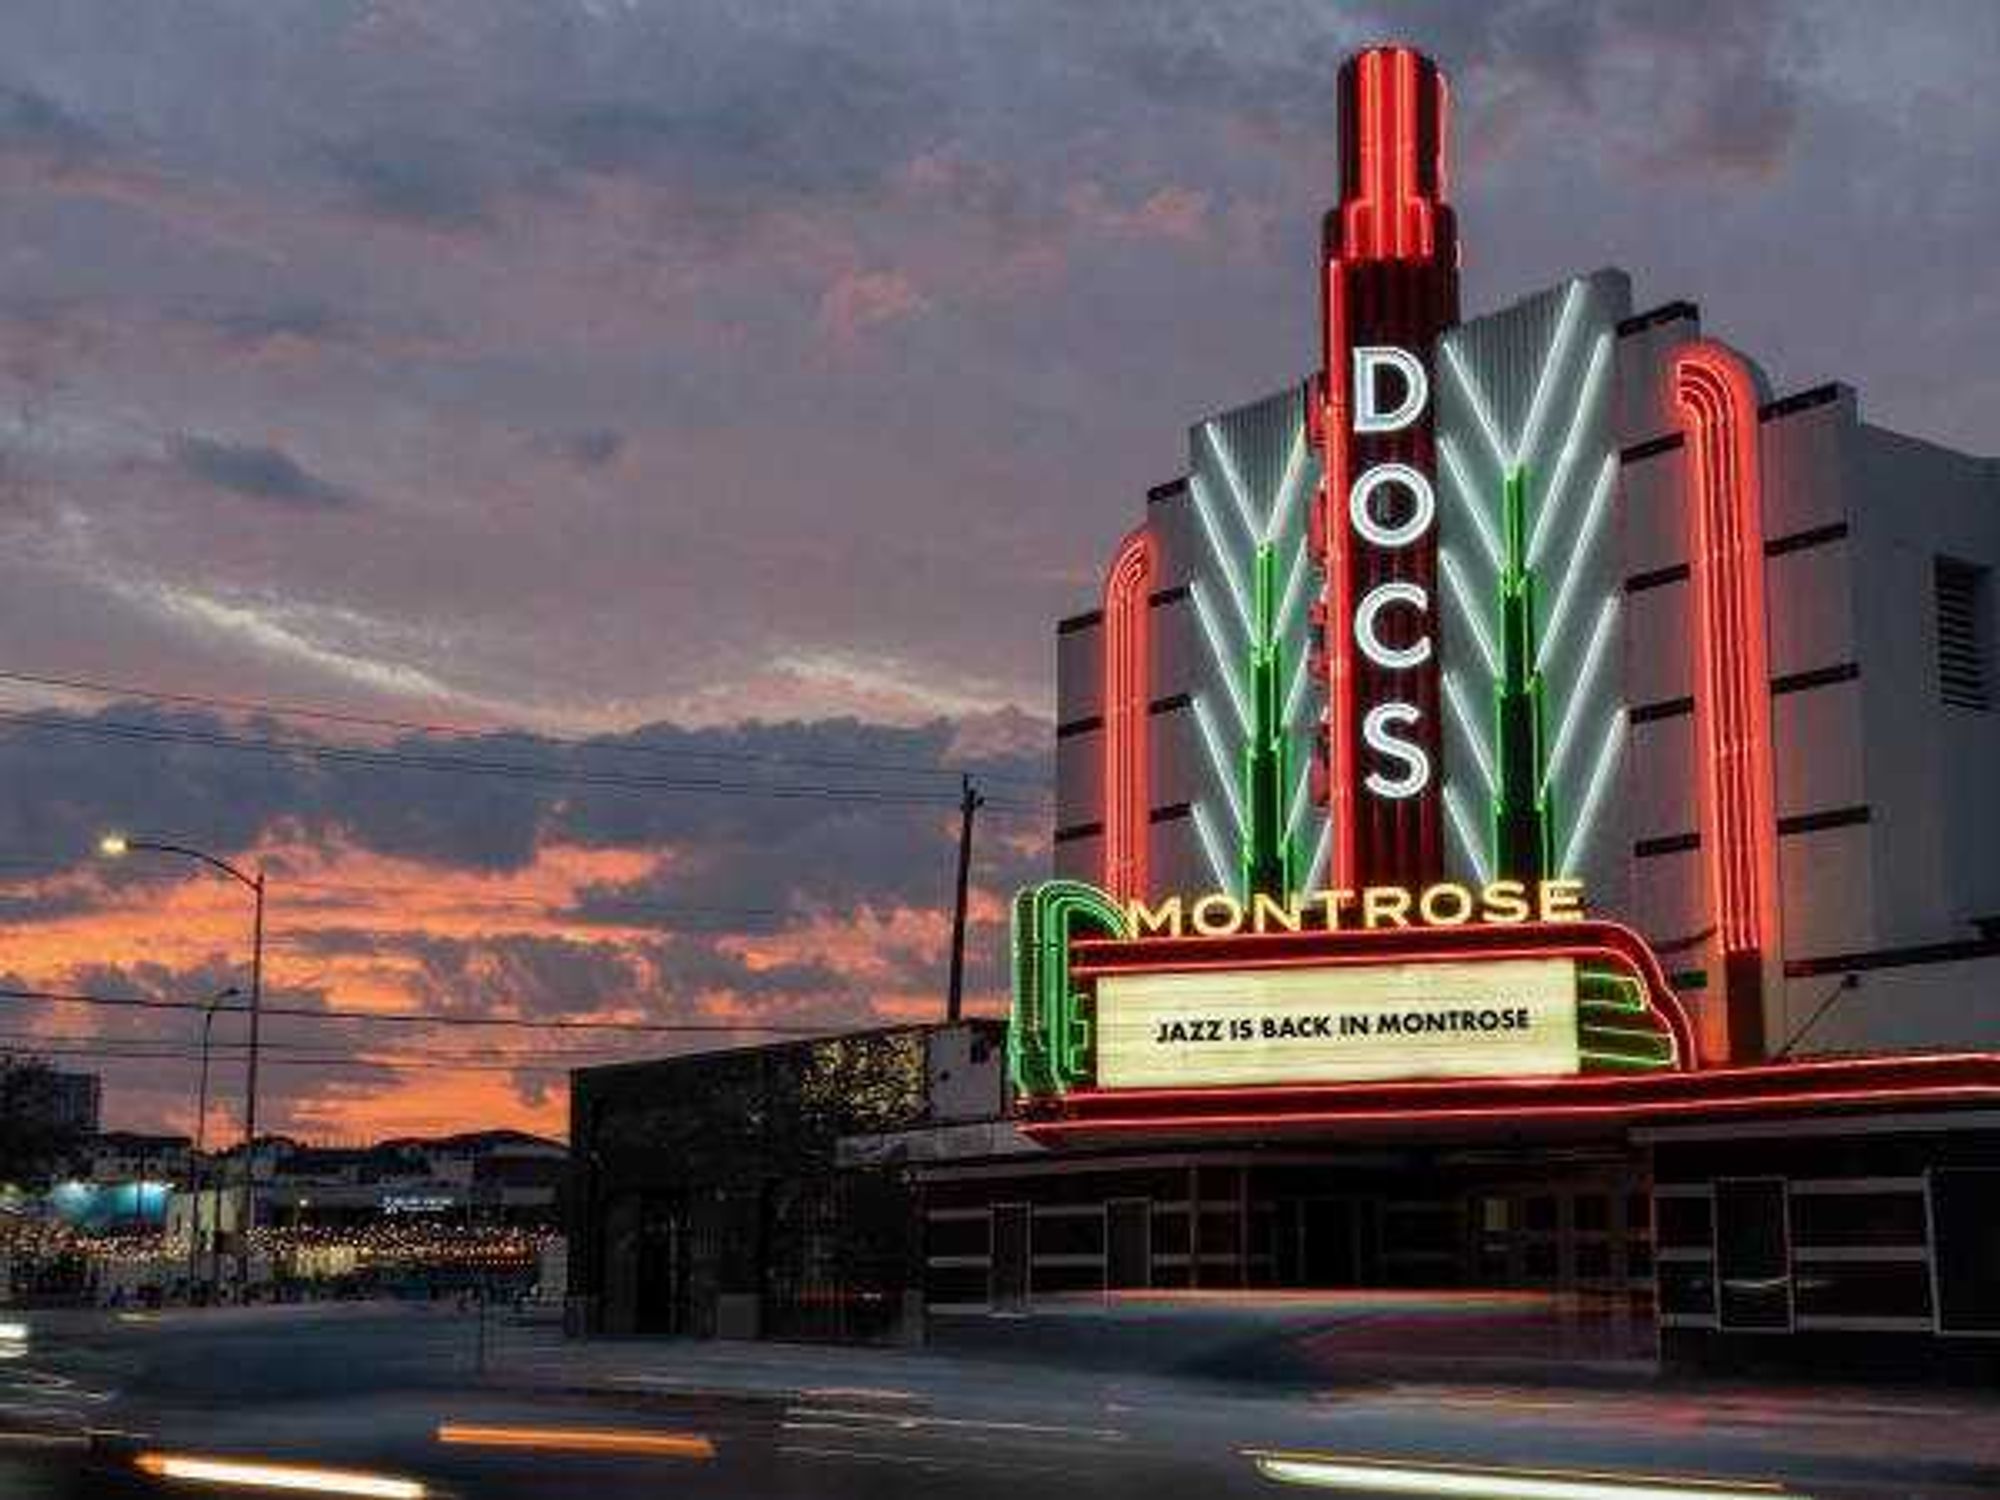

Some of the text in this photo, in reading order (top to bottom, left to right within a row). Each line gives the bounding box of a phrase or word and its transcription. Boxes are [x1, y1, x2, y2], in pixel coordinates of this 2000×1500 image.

[1349, 346, 1435, 798] DOCS
[1127, 878, 1585, 939] MONTROSE
[1156, 1008, 1530, 1043] JAZZ IS BACK IN MONTROSE
